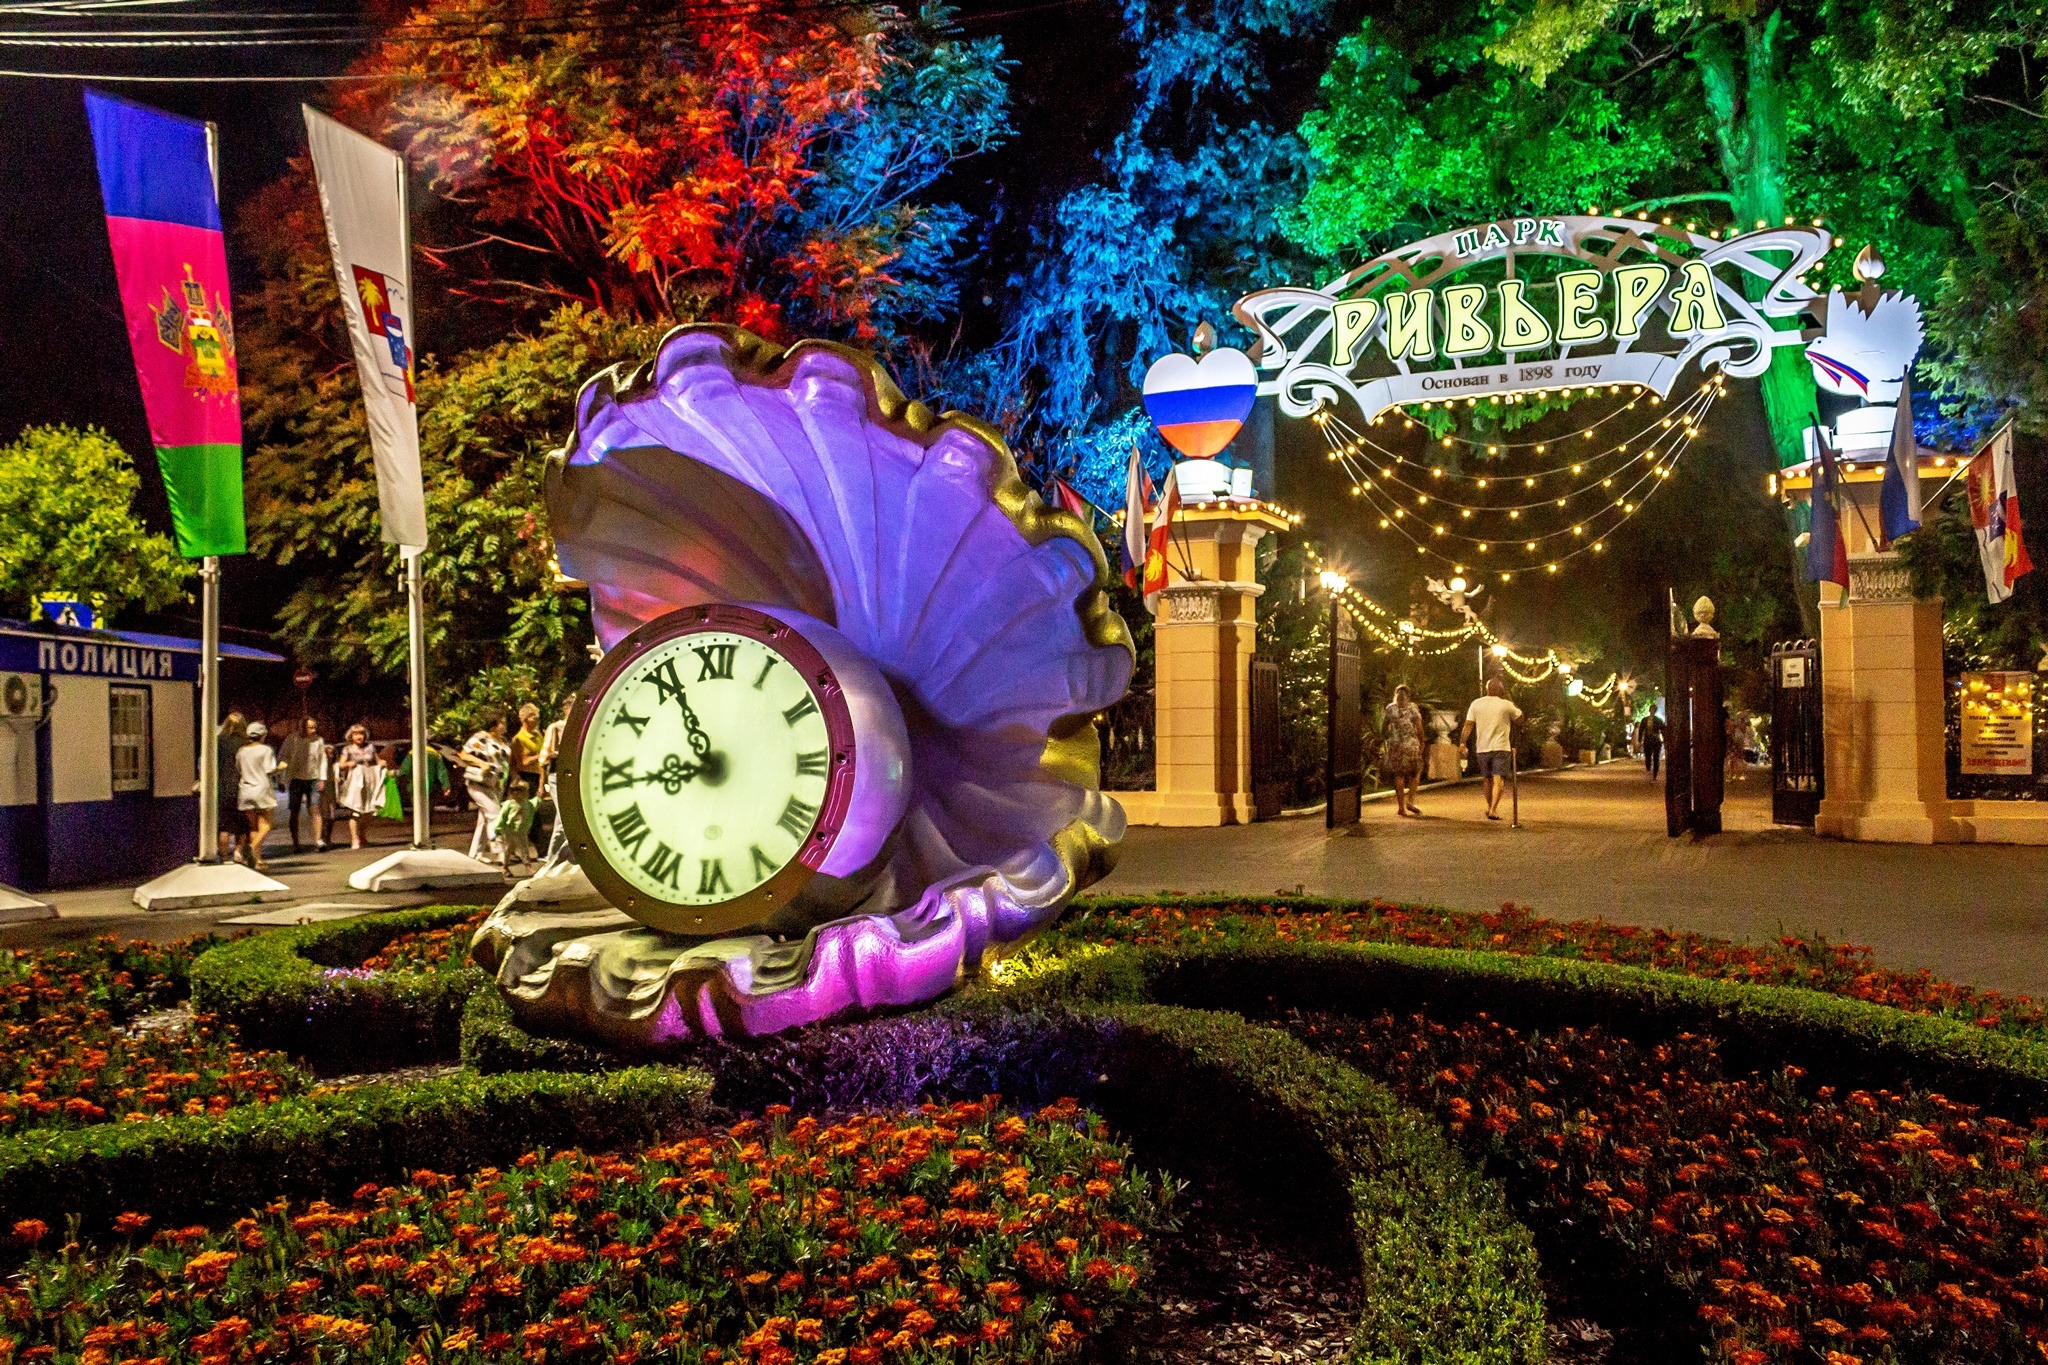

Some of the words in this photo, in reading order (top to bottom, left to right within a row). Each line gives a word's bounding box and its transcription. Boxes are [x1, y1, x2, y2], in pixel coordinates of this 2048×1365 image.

[1453, 219, 1565, 257] ПАРК
[1330, 259, 1728, 369] РИВЬЕРА
[1421, 374, 1489, 391] Основан
[1500, 374, 1508, 383] в
[1519, 366, 1553, 382] 1898
[1564, 364, 1602, 379] году
[38, 640, 173, 678] ПОЛИЦИЯ
[692, 644, 739, 682] XII
[612, 702, 651, 738] X
